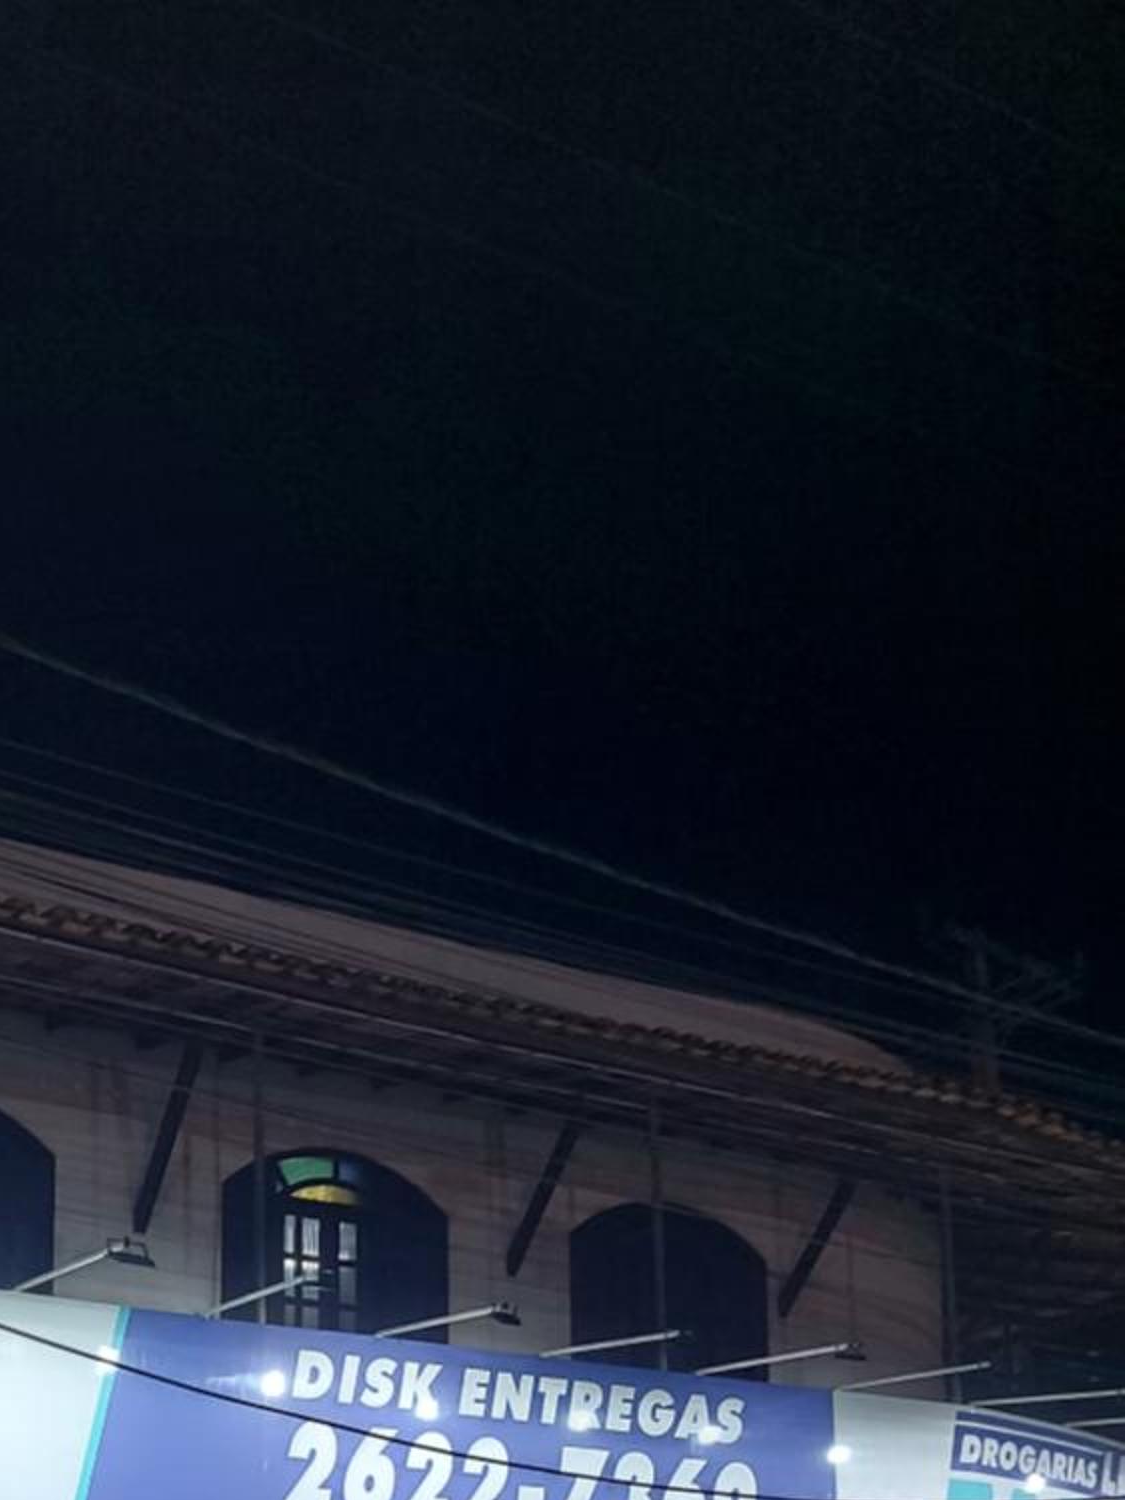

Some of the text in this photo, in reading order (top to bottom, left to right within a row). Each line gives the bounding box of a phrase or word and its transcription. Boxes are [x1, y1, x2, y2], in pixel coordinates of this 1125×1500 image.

[291, 1349, 745, 1444] DISK ENTREGAS
[959, 1433, 1099, 1489] DROGARIAS
